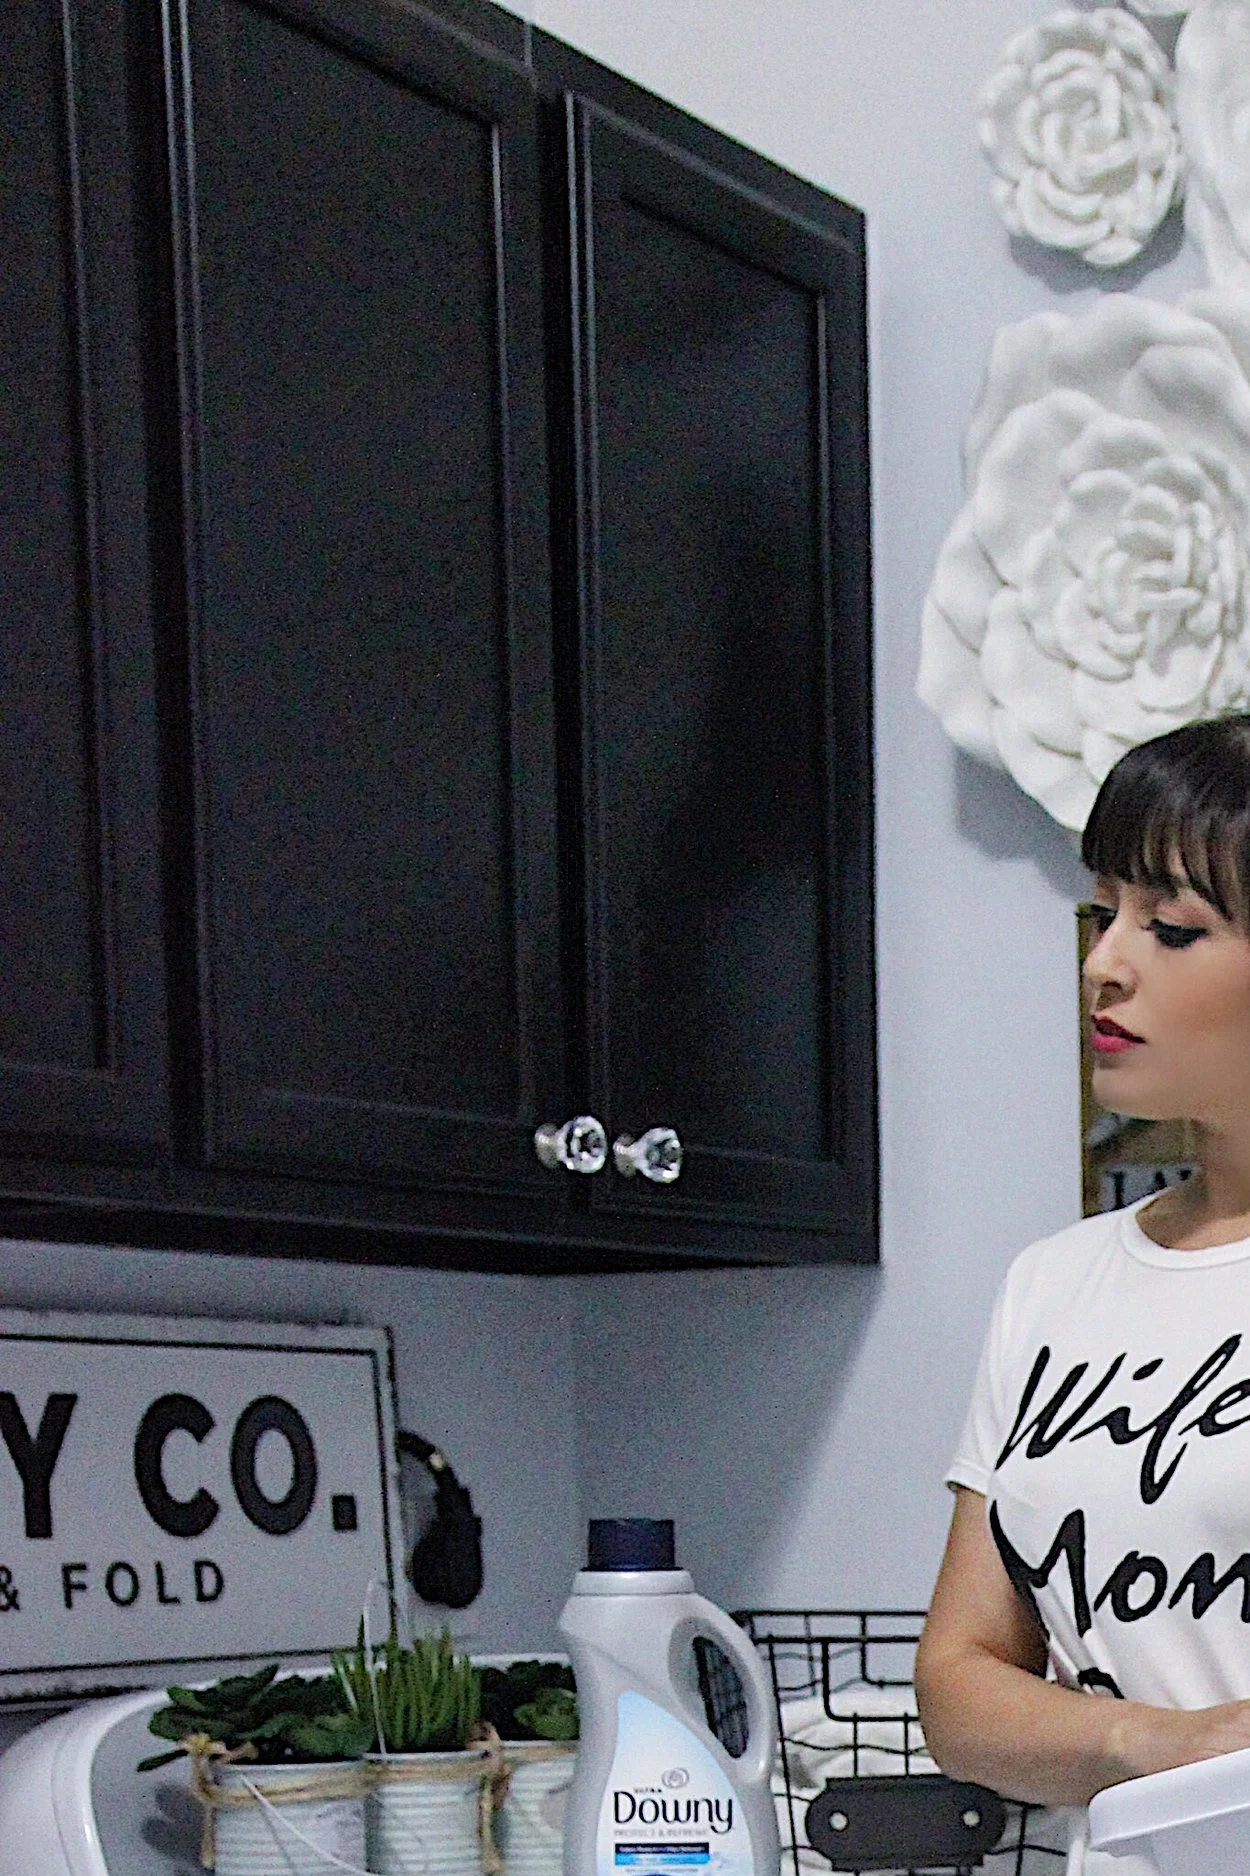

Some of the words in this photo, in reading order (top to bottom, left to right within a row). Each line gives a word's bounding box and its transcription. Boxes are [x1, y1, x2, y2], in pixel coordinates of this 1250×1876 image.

[0, 1391, 78, 1538] Y
[133, 1393, 358, 1538] CO.
[61, 1559, 225, 1610] FOLD
[613, 1790, 733, 1834] Downy
